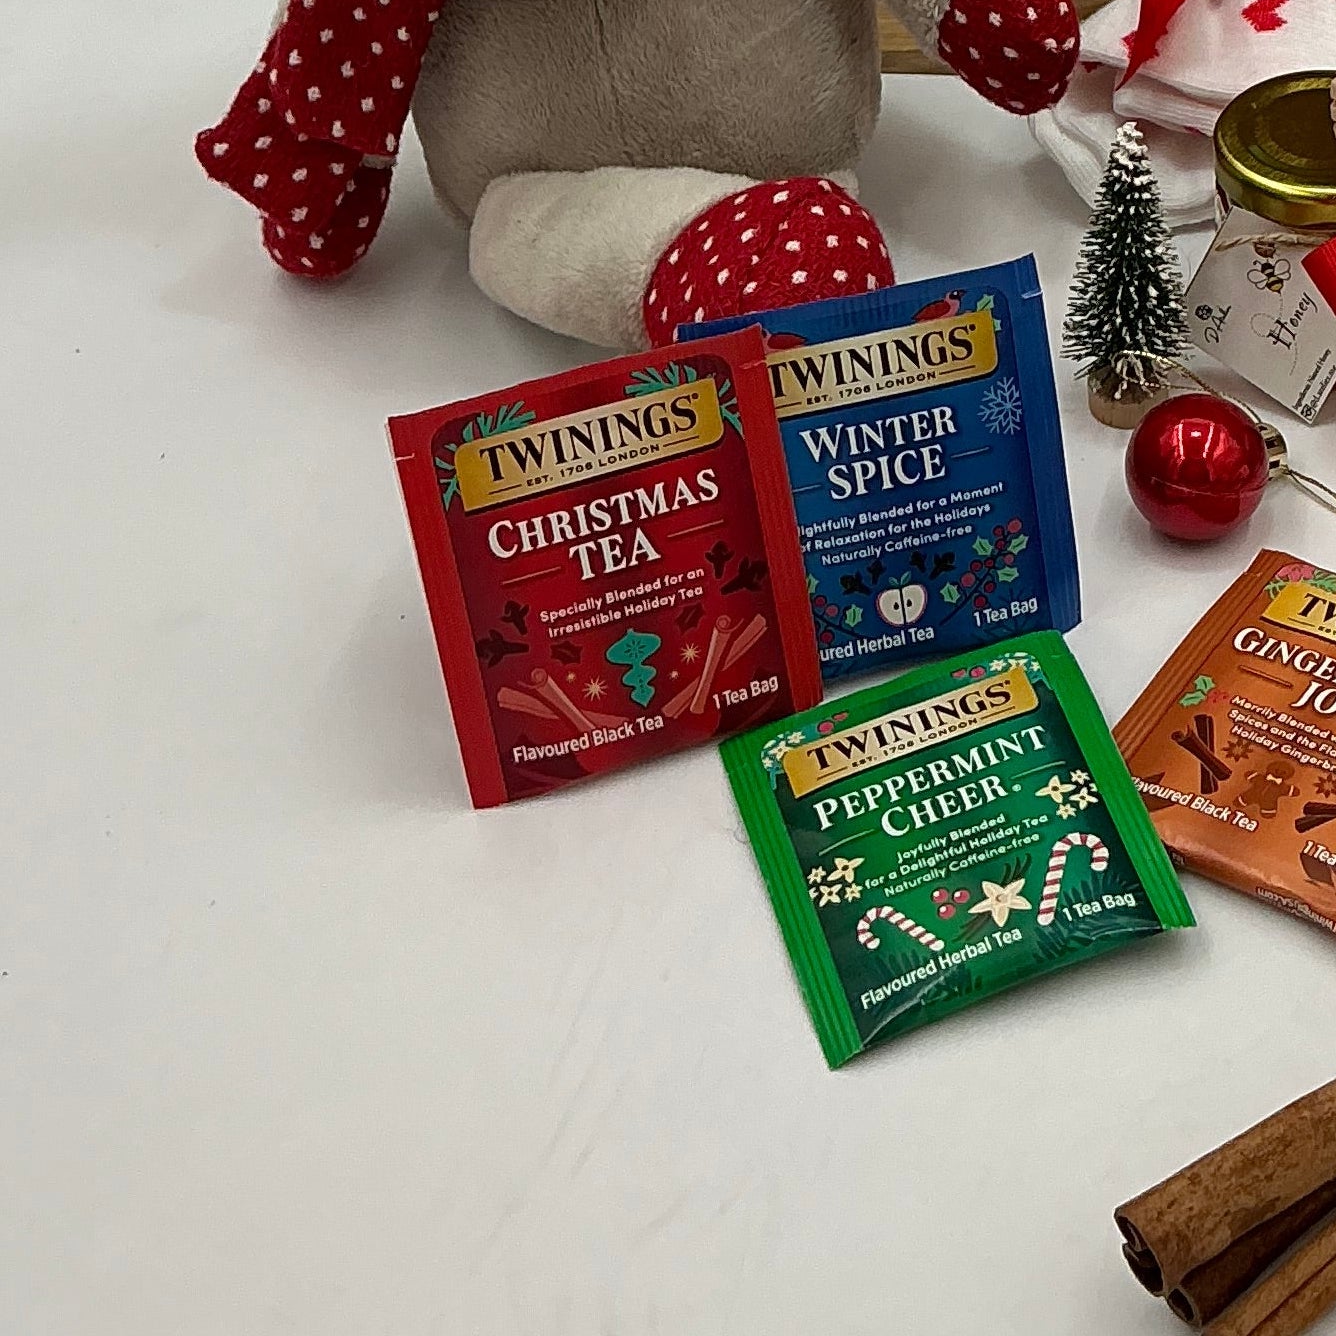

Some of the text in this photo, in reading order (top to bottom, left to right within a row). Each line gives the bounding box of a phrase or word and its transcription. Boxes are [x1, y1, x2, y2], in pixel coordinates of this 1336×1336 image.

[1267, 292, 1318, 350] Honey
[876, 371, 937, 391] LONDON
[598, 443, 660, 468] LONDON
[799, 406, 957, 463] WINTER
[828, 444, 946, 500] SPICE
[487, 468, 719, 559] CHRISTMAS
[860, 482, 1004, 523] Blended for a Moment
[814, 503, 991, 551] Relaxation for the Holidays
[568, 527, 662, 581] TEA
[822, 544, 882, 566] Naturally
[539, 568, 705, 623] Specially Blended for an
[548, 585, 704, 638] Irresistible Holiday Tea
[974, 597, 1038, 626] 1 Tea Bag
[857, 634, 906, 656] Herbal
[908, 626, 935, 642] Tea
[713, 675, 779, 710] 1 Tea Bag
[919, 718, 978, 743] LONDON
[1229, 709, 1268, 733] Spices
[1269, 725, 1294, 742] and
[1296, 733, 1317, 749] the
[1231, 695, 1276, 721] Merrily
[1277, 713, 1330, 739] Blended
[1232, 725, 1279, 750] Holiday
[512, 715, 664, 764] Flavoured Black Tea
[812, 724, 1047, 831] PEPPERMINT
[1191, 791, 1259, 832] Black Tea
[864, 814, 1048, 891] for a Delightful Holiday Tea
[897, 814, 1006, 865] Joyfully Blended
[1303, 840, 1313, 853] 1
[883, 870, 946, 898] Naturally
[1063, 891, 1135, 922] 1 Tea Bag
[860, 927, 1023, 1010] Flavoured Herbal Tea
